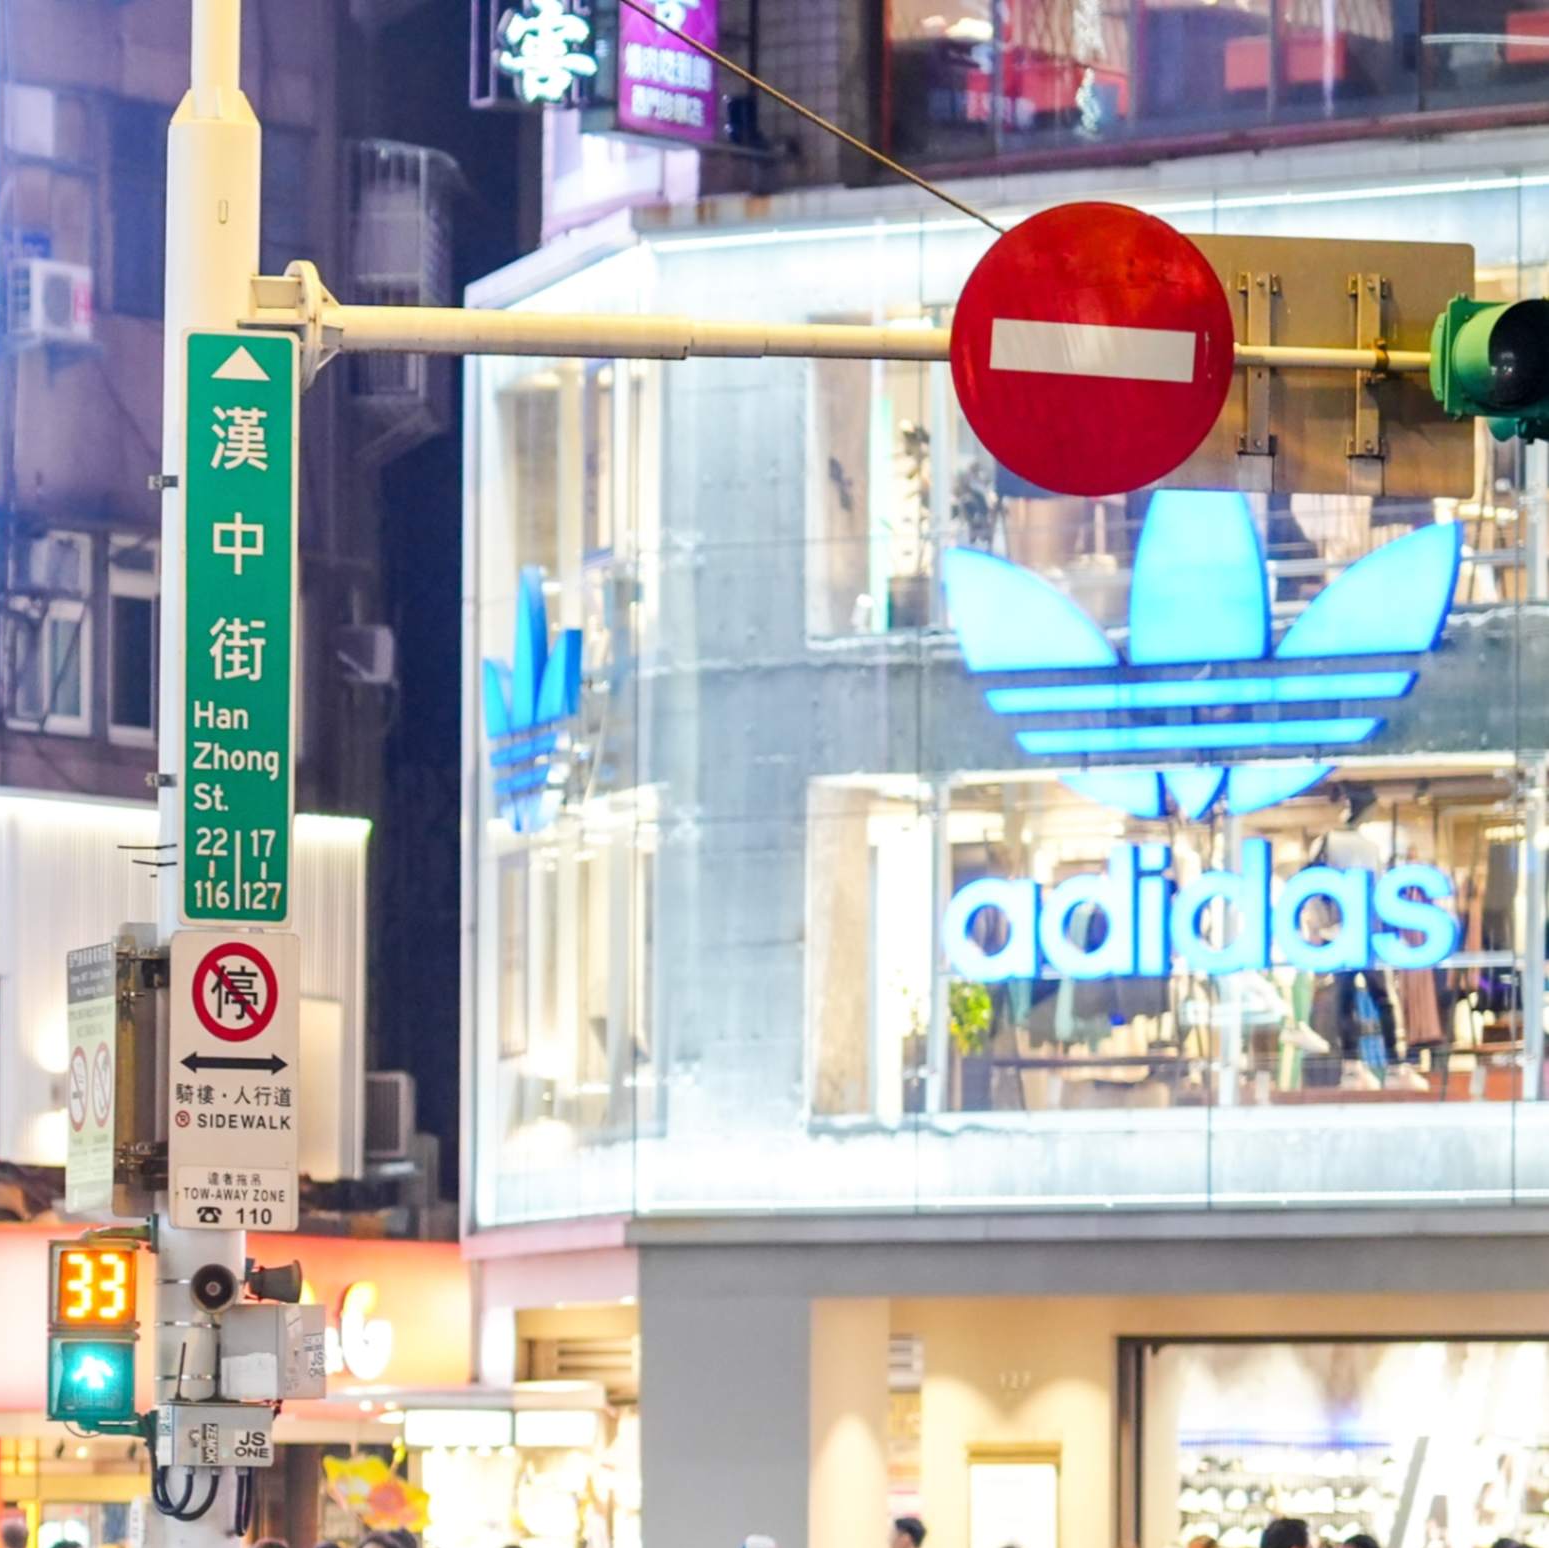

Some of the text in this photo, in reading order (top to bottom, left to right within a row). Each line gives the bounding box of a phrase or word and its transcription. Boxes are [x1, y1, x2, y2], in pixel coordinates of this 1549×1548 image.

[209, 406, 268, 682] 漢中街
[193, 701, 249, 731] Han
[193, 742, 280, 780] Zhong
[193, 784, 229, 812] St.
[195, 829, 276, 858] 22 17
[194, 881, 282, 911] 116 127
[941, 837, 1462, 982] adidas
[211, 964, 259, 1020] 停
[197, 1113, 291, 1130] SIDEWALK
[183, 1186, 285, 1203] TOW-AWAY ZONE
[235, 1207, 272, 1225] 110
[66, 1252, 126, 1318] 33
[235, 1447, 269, 1458] ONE
[239, 1431, 265, 1446] JS
